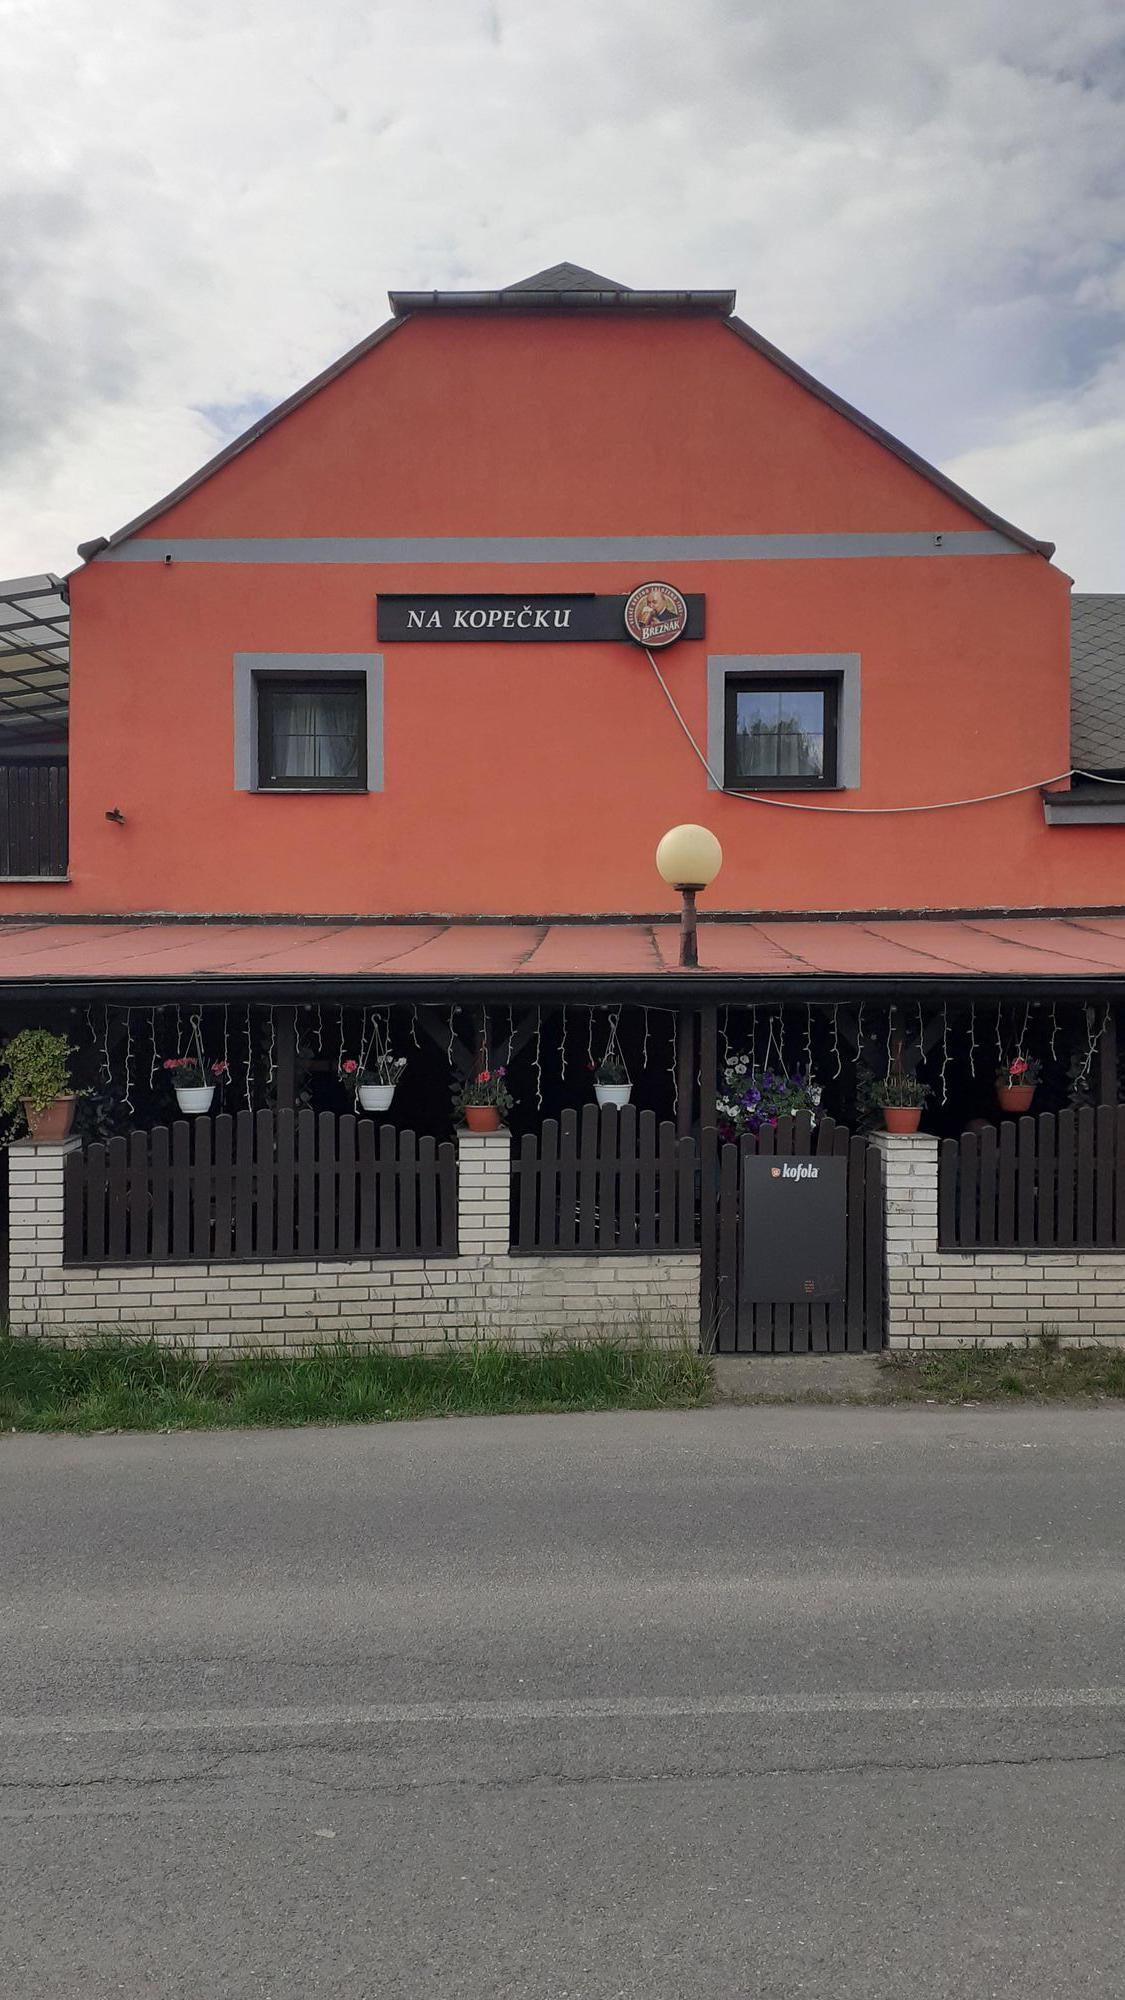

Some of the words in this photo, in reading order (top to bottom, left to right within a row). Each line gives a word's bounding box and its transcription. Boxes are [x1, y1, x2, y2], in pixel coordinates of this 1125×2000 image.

[407, 610, 442, 628] NA
[453, 605, 571, 628] KOPEČKU
[782, 1163, 818, 1182] kofola
